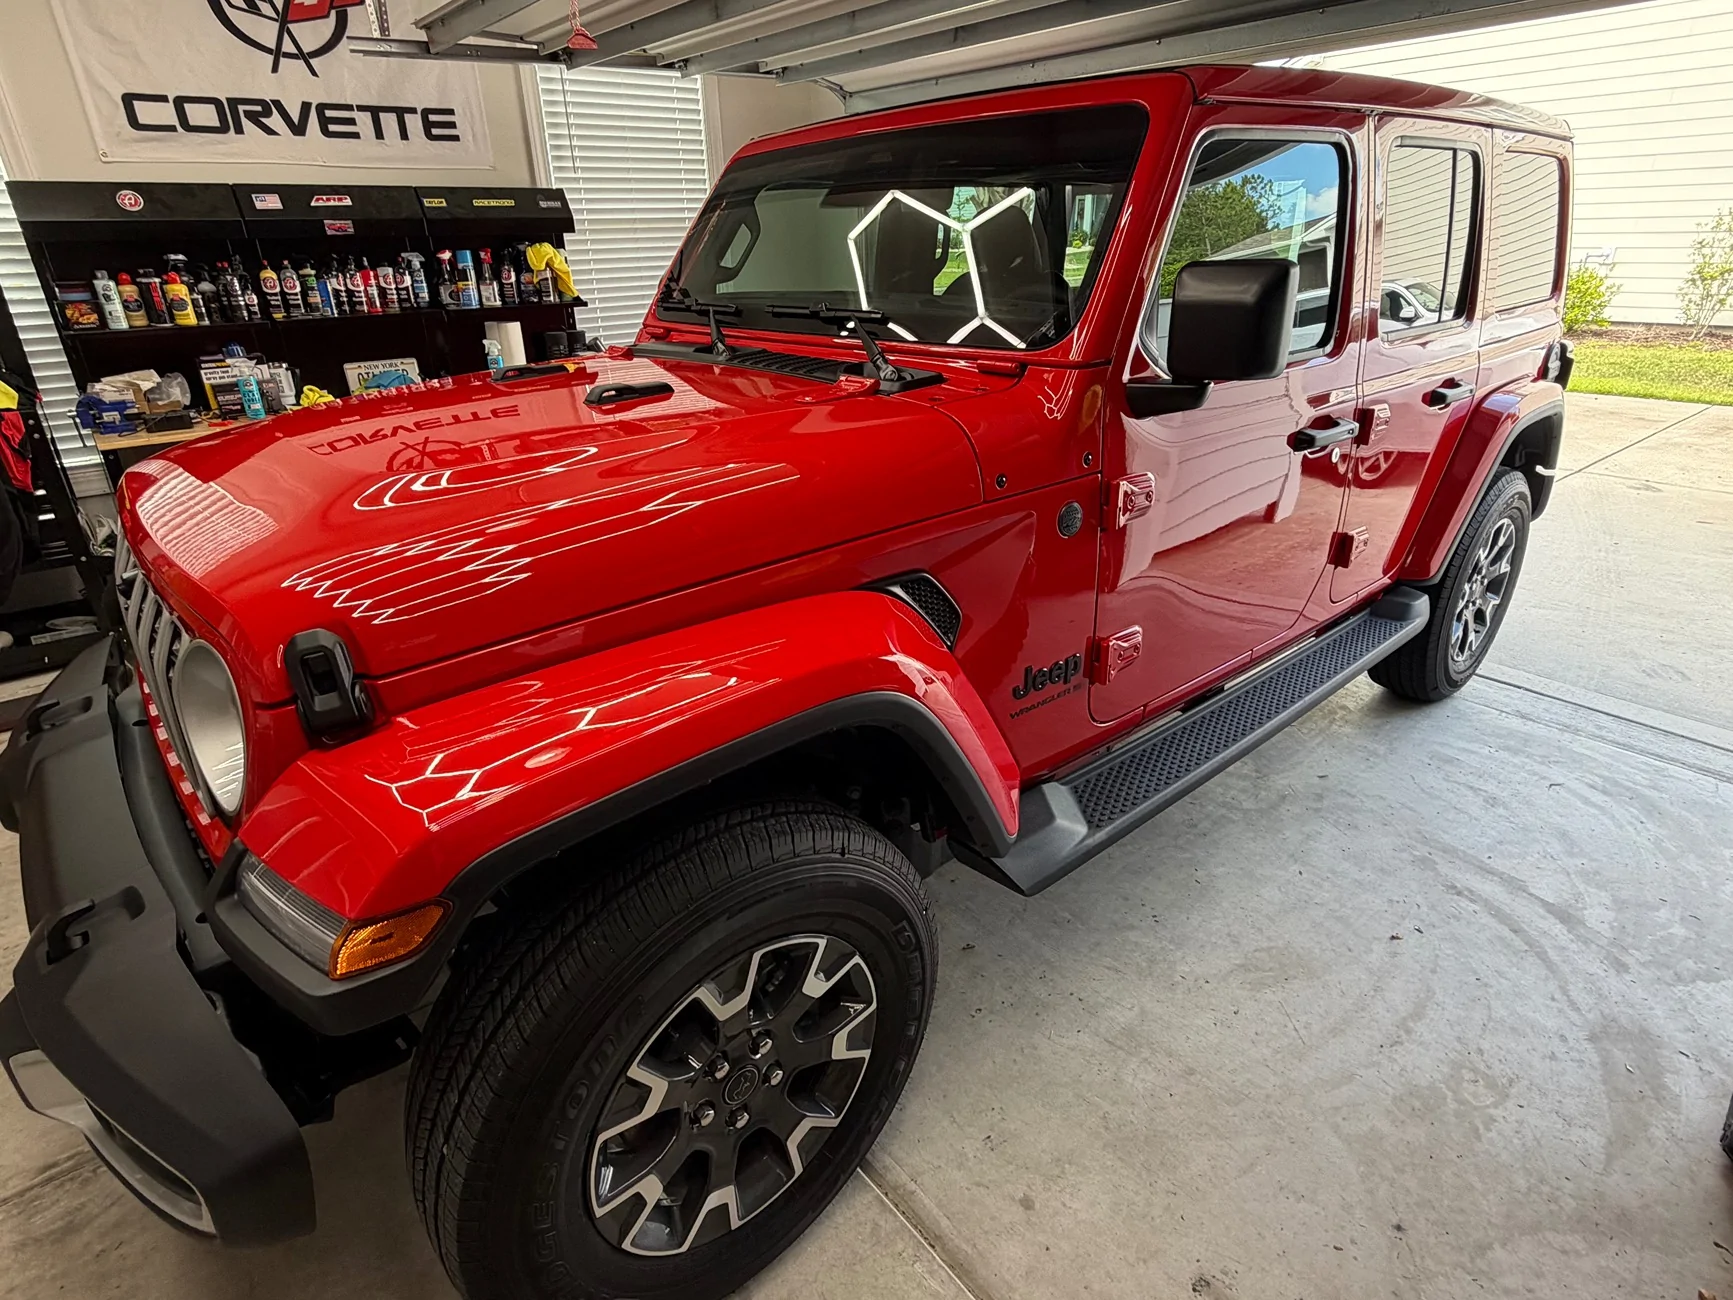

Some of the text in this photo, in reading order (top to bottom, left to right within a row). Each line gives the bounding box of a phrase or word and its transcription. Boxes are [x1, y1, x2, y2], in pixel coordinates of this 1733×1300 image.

[121, 92, 461, 142] CORVETTE
[381, 361, 400, 369] YORK
[1012, 652, 1082, 700] Jeep
[1010, 688, 1071, 719] WRANGLER
